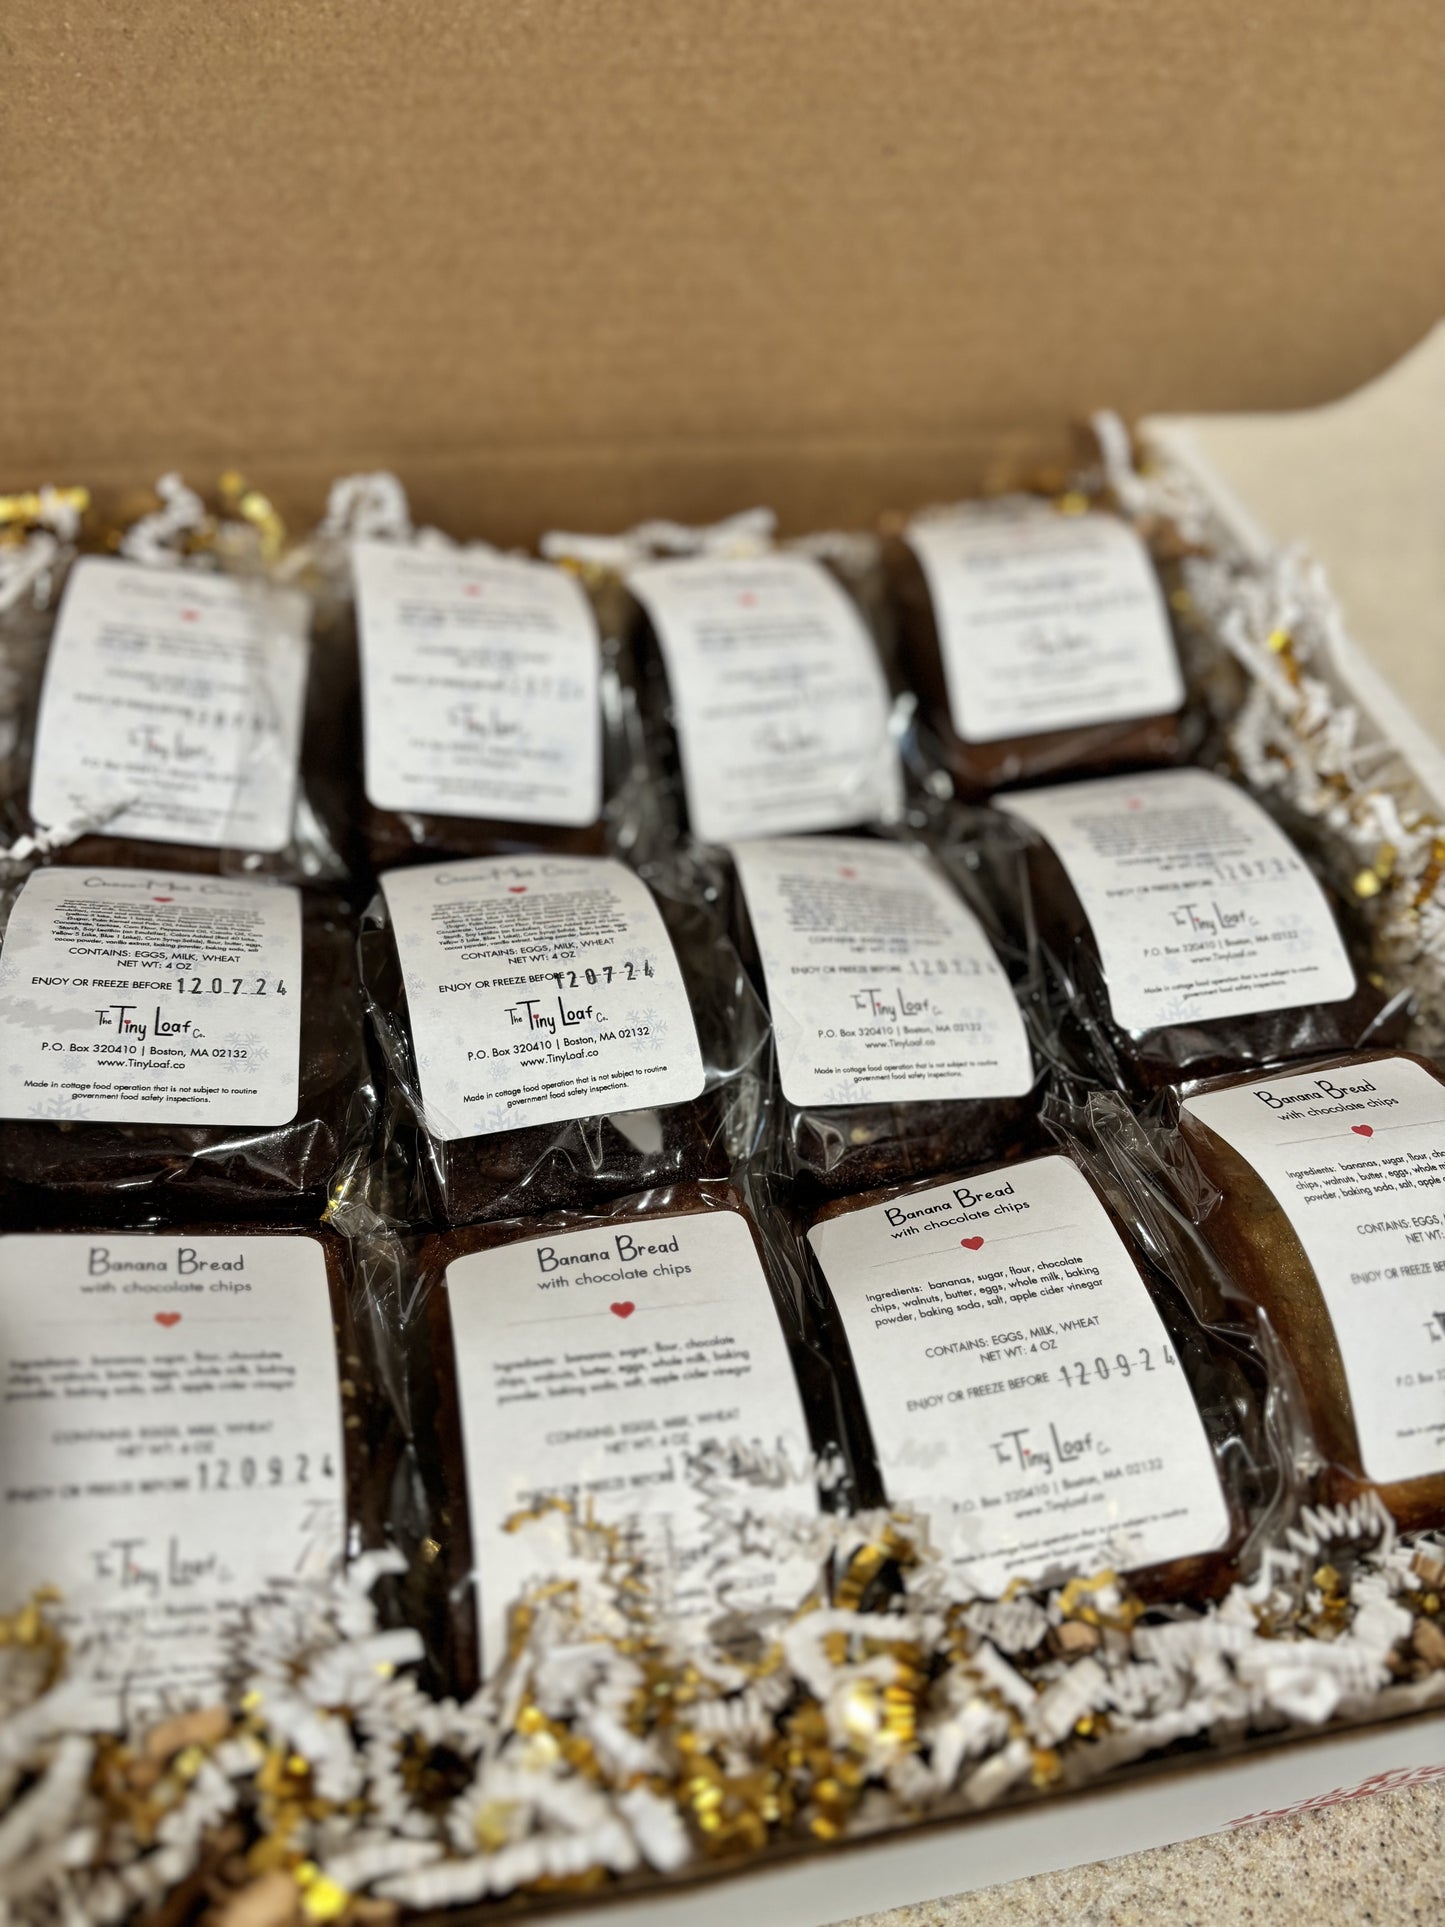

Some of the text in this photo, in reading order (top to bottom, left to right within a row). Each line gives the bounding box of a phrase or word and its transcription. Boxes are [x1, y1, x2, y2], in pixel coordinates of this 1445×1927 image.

[68, 947, 131, 957] CONTAINS:
[135, 951, 168, 960] EGGS,
[171, 953, 198, 961] MILK,
[461, 937, 614, 960] CONTAINS: EGGS, MILK, WHEAT
[508, 956, 527, 965] NET
[529, 954, 549, 962] WT:
[560, 951, 576, 959] OZ
[117, 960, 138, 968] NET
[141, 961, 162, 969] WT:
[175, 962, 193, 970] OZ
[31, 976, 69, 986] ENJOY
[72, 978, 89, 987] OR
[92, 979, 129, 989] FREEZE
[132, 981, 172, 990] BEFORE
[439, 982, 472, 993] ENJOY
[475, 980, 490, 989] OR
[492, 976, 527, 987] FREEZE
[95, 1010, 112, 1026] The
[109, 1005, 147, 1042] Tiny
[154, 1006, 192, 1037] Loaf
[504, 1008, 523, 1025] The
[516, 1000, 556, 1035] Tiny
[558, 996, 593, 1026] Loaf
[41, 1042, 248, 1059] P.O. Box 320410 Boston, MA 02132
[467, 1026, 650, 1061] P.O. Box 320410 Boston, MA 02132
[97, 1058, 186, 1070] www.TinyLoaf.co
[520, 1049, 599, 1067] www.TinyLoaf.co
[24, 1080, 48, 1088] Made
[60, 1082, 91, 1090] cottage
[93, 1082, 111, 1090] food
[113, 1084, 151, 1092] operation
[153, 1084, 168, 1092] that
[193, 1086, 220, 1095] subject
[71, 1092, 211, 1103] government food safety inspections.
[463, 1093, 485, 1103] Made
[495, 1088, 522, 1098] cottage
[523, 1083, 540, 1093] food
[541, 1080, 575, 1091] operation
[575, 1076, 589, 1084] that
[598, 1073, 610, 1081] not
[611, 1070, 634, 1079] subject
[644, 1065, 668, 1075] routine
[507, 1081, 630, 1109] government food safety inspections.
[1253, 1078, 1377, 1109] Banana Bread
[1278, 1097, 1399, 1121] with chocolate chips
[1285, 1152, 1432, 1179] Ingredients: bananas, sugar, flour,
[1296, 1163, 1438, 1190] chips, walnuts, butter, eggs, whole
[1304, 1175, 1441, 1205] powder, baking soda, salt, apple
[884, 1181, 1015, 1227] Banana Bread
[890, 1201, 1030, 1239] with chocolate chips
[1356, 1214, 1443, 1235] CONTAINS: EGGS,
[88, 1247, 245, 1277] Banana Bread
[537, 1234, 680, 1273] Banana Bread
[79, 1280, 253, 1295] with chocolate chips
[537, 1263, 692, 1290] with chocolate chips
[865, 1256, 1083, 1304] Ingredients: bananas, sugar, flour, chocolate
[870, 1267, 1100, 1314] chips, walnuts, butter, eggs, whole milk, baking
[874, 1278, 1103, 1329] powder, baking soda, salt, apple cider vinegar
[925, 1315, 1100, 1359] CONTAINS: EGGS, MILK, WHEAT
[980, 1349, 1001, 1364] NET
[1030, 1343, 1038, 1353] 4
[1040, 1339, 1058, 1351] OZ
[906, 1394, 944, 1412] ENJOY
[947, 1390, 965, 1402] OR
[966, 1381, 1005, 1398] FREEZE
[1007, 1371, 1050, 1390] BEFORE
